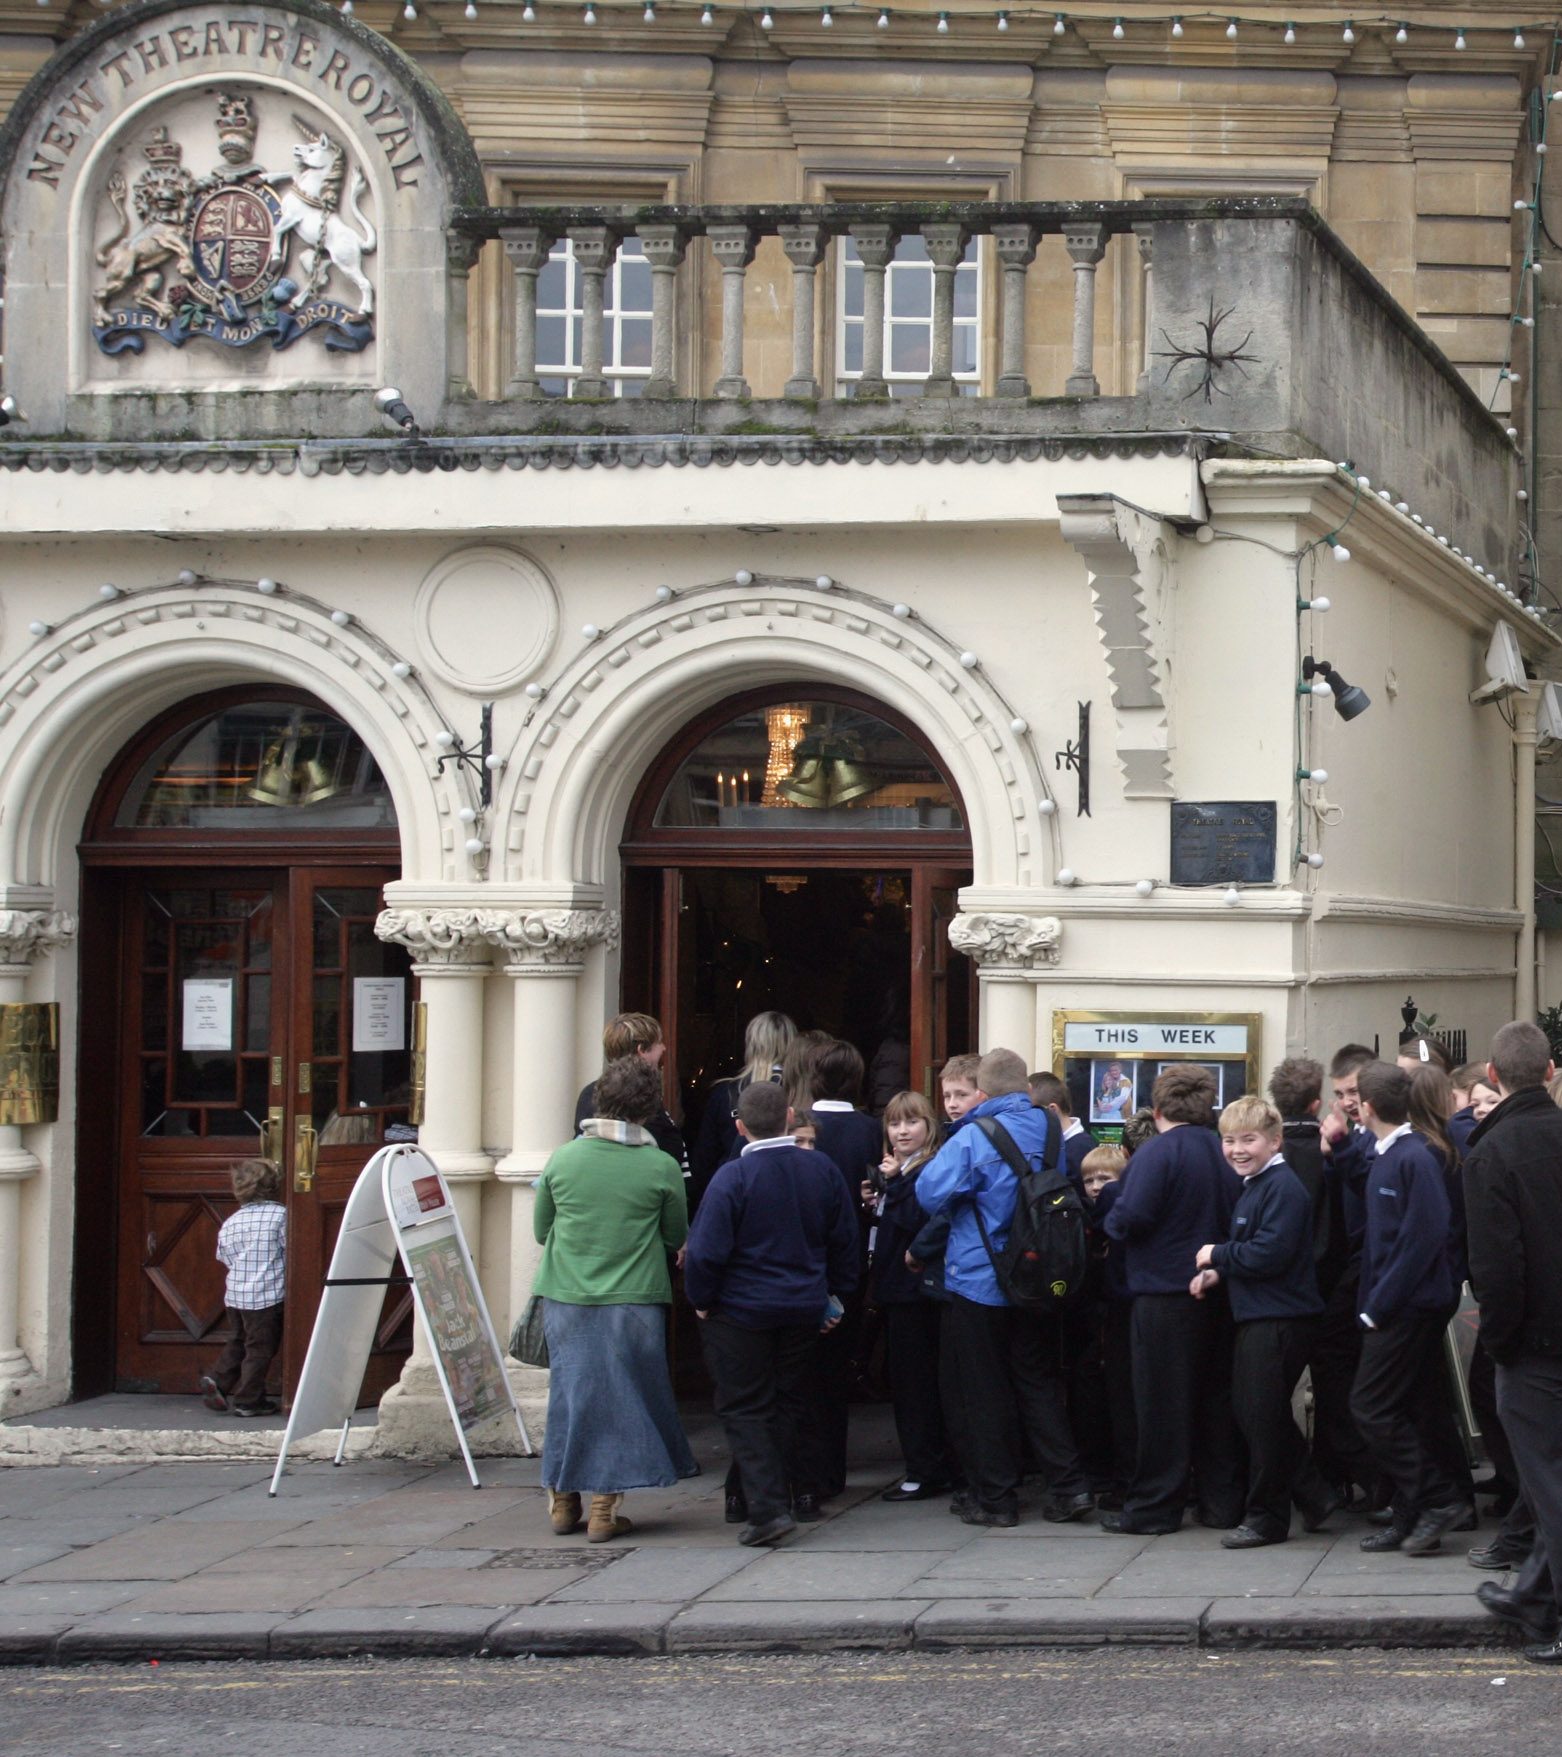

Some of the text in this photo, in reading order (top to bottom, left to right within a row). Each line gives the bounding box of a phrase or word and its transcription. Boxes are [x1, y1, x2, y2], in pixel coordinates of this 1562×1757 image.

[27, 20, 425, 192] NEW THEATRE ROYAL
[116, 313, 168, 331] DIEU
[222, 318, 267, 341] MON
[297, 304, 356, 329] DROIT
[1095, 1029, 1216, 1044] THIS WEEK
[438, 1327, 479, 1352] Beanstal
